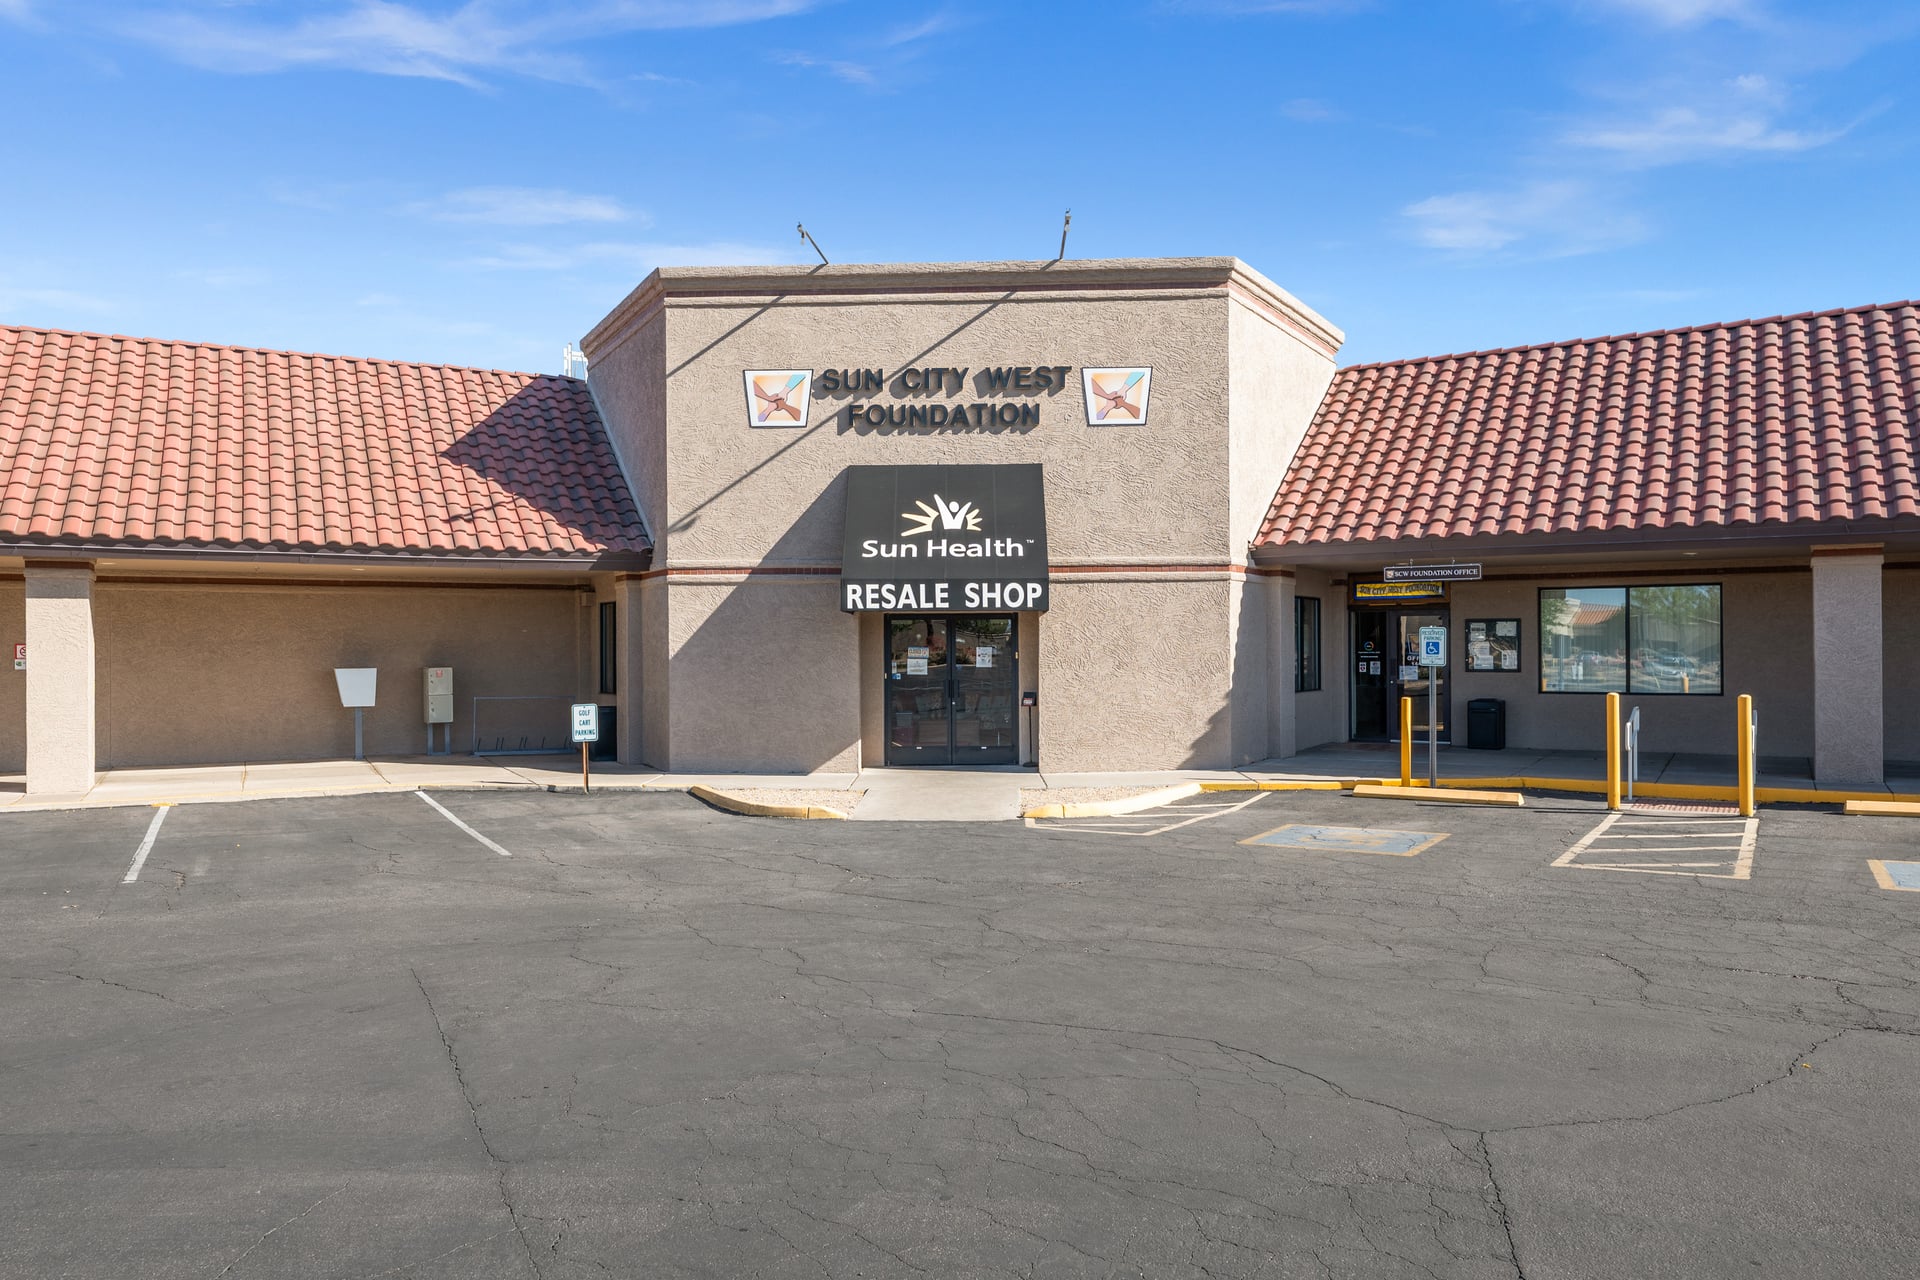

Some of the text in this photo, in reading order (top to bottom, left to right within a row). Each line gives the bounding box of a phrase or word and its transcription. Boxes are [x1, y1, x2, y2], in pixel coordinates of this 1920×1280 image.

[822, 366, 1073, 391] SUN CITY WEST
[848, 403, 1041, 427] FOUNDATION
[862, 540, 917, 558] Sun
[927, 538, 1024, 558] Health
[1394, 569, 1409, 577] SCW
[1410, 569, 1453, 577] FOUNDATION
[846, 582, 1043, 609] RESALE SHOP
